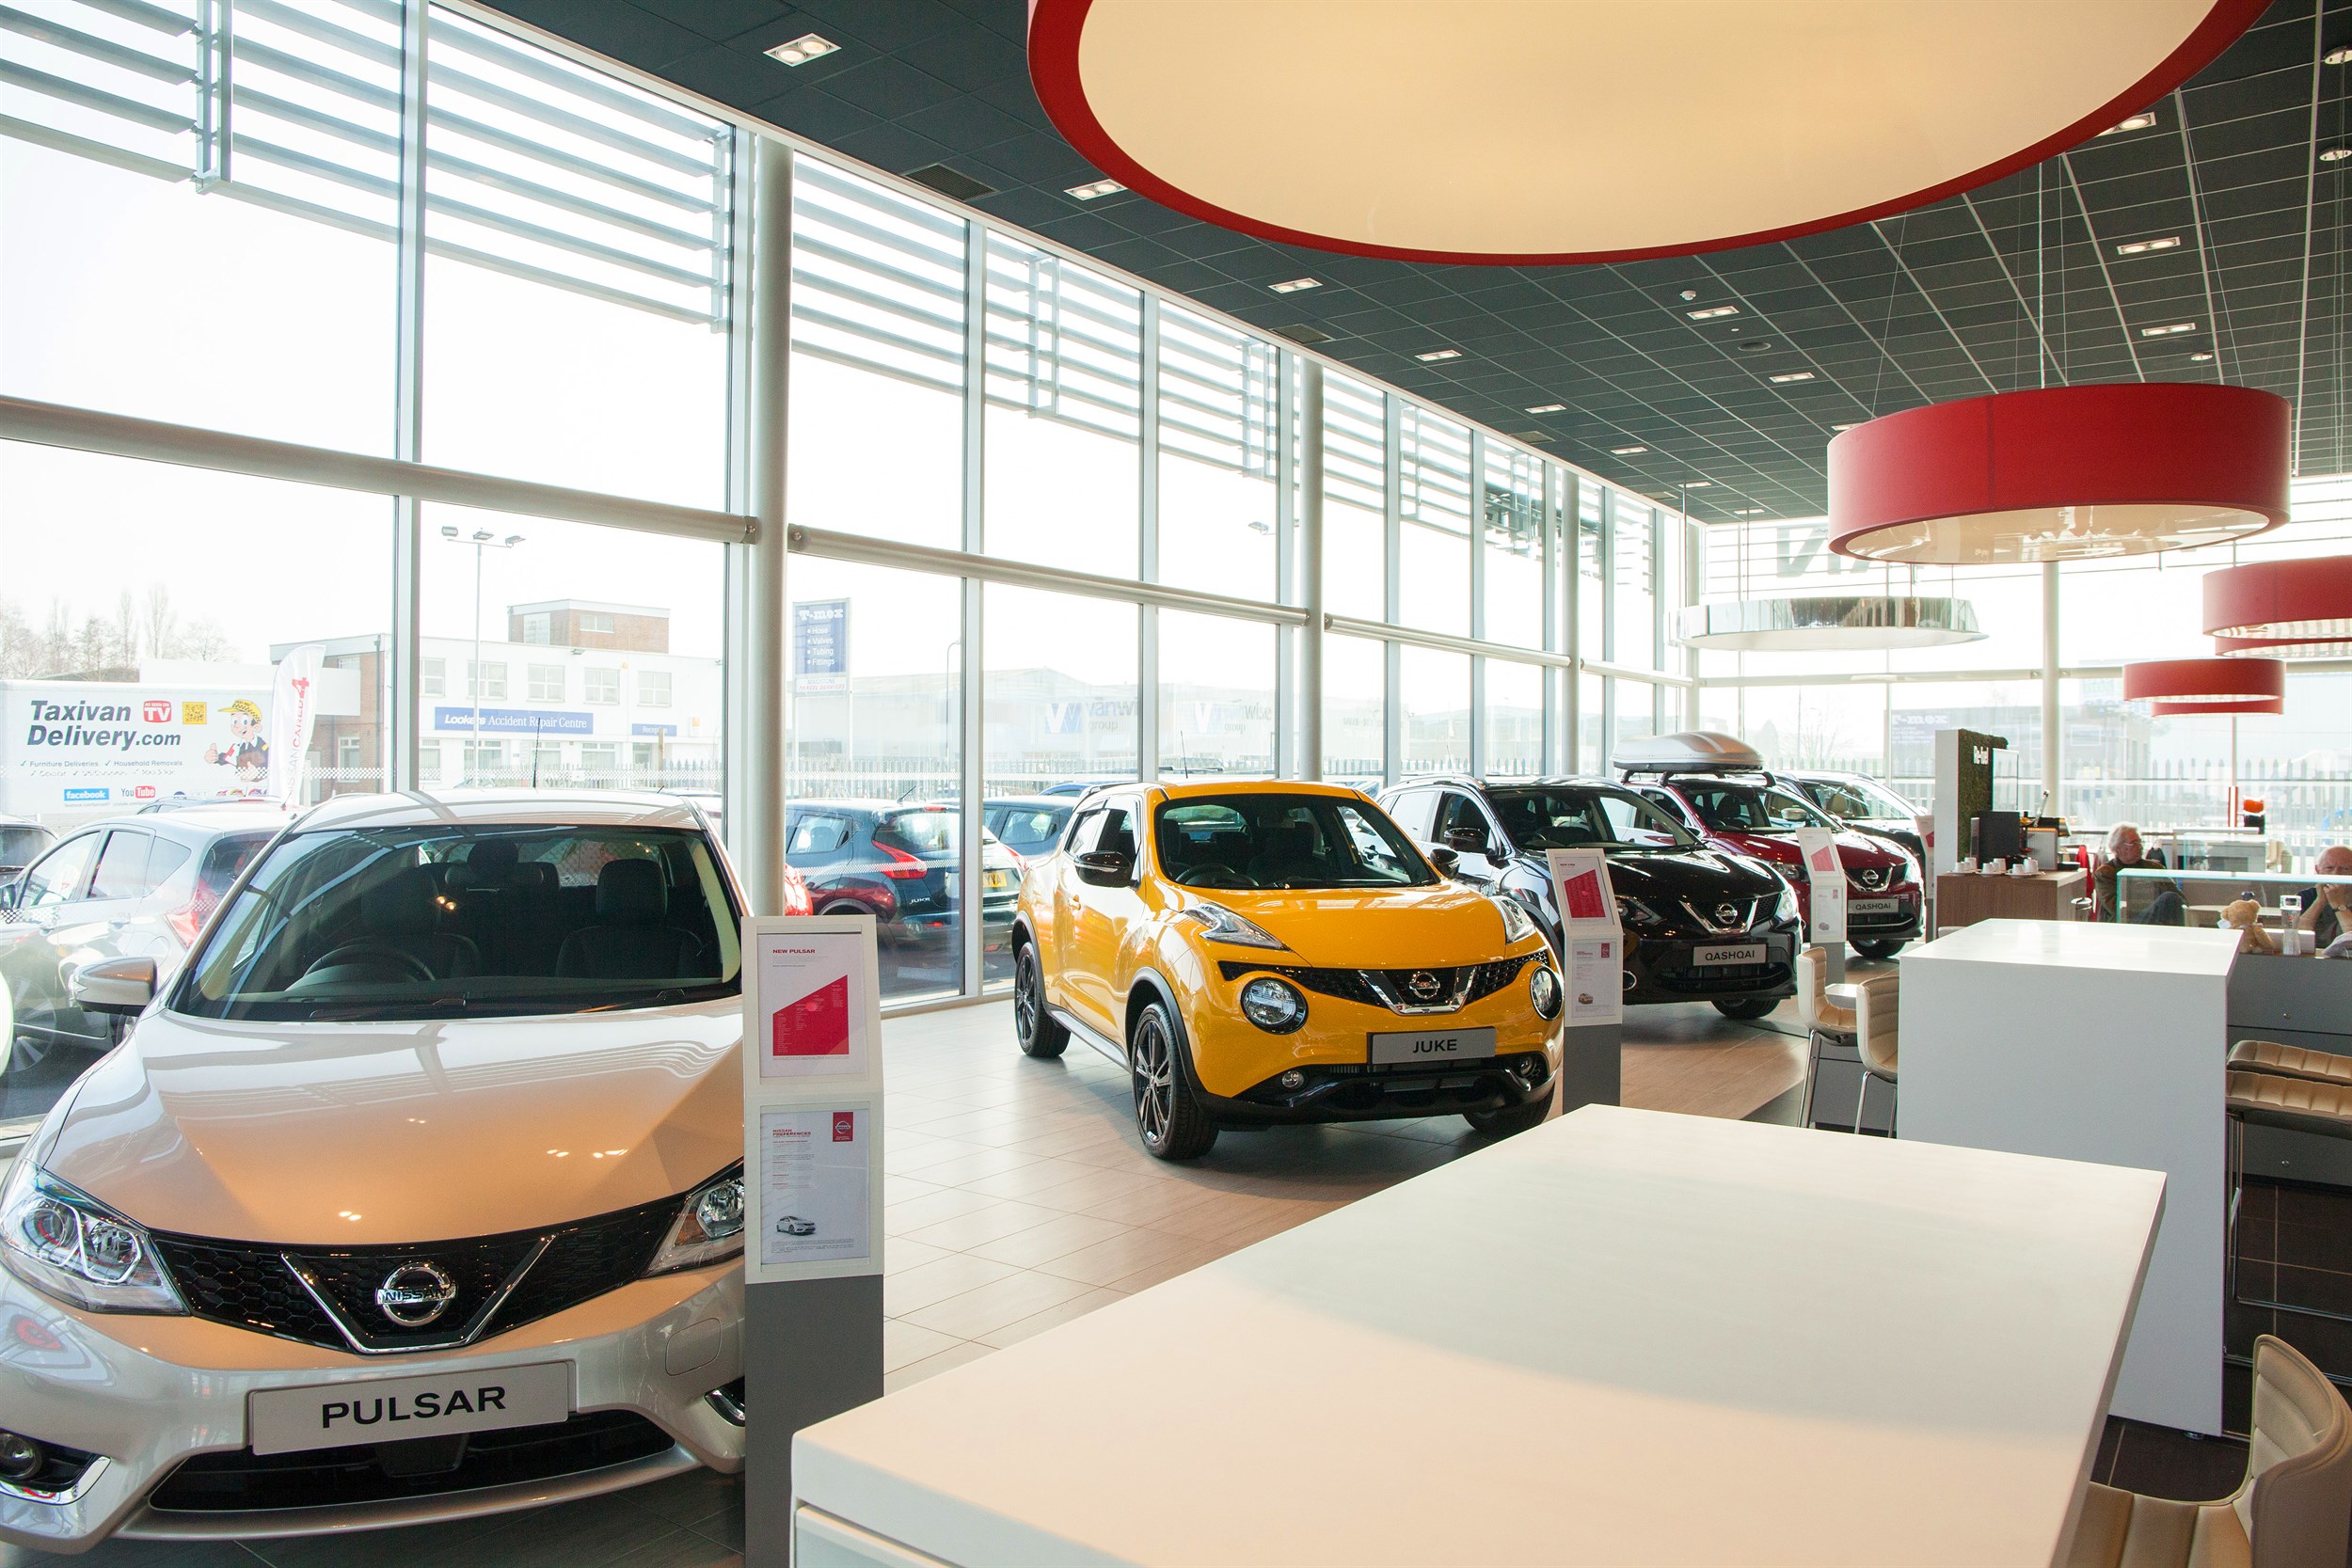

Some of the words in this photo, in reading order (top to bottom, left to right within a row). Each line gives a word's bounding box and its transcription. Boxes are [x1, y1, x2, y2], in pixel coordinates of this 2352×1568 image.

[812, 648, 834, 657] Tubing
[812, 658, 834, 667] Fittings
[31, 700, 132, 721] Taxivan
[144, 707, 170, 721] TV
[488, 715, 527, 726] Accident
[530, 716, 557, 730] Repair
[559, 717, 587, 728] Centre
[1089, 720, 1119, 732] group
[27, 725, 182, 752] Delivery.com
[66, 790, 106, 800] facebook
[1705, 950, 1756, 961] QASHQAI
[1412, 1038, 1457, 1053] JUKE
[385, 1287, 447, 1301] NISSAN
[322, 1386, 506, 1429] PULSAR
